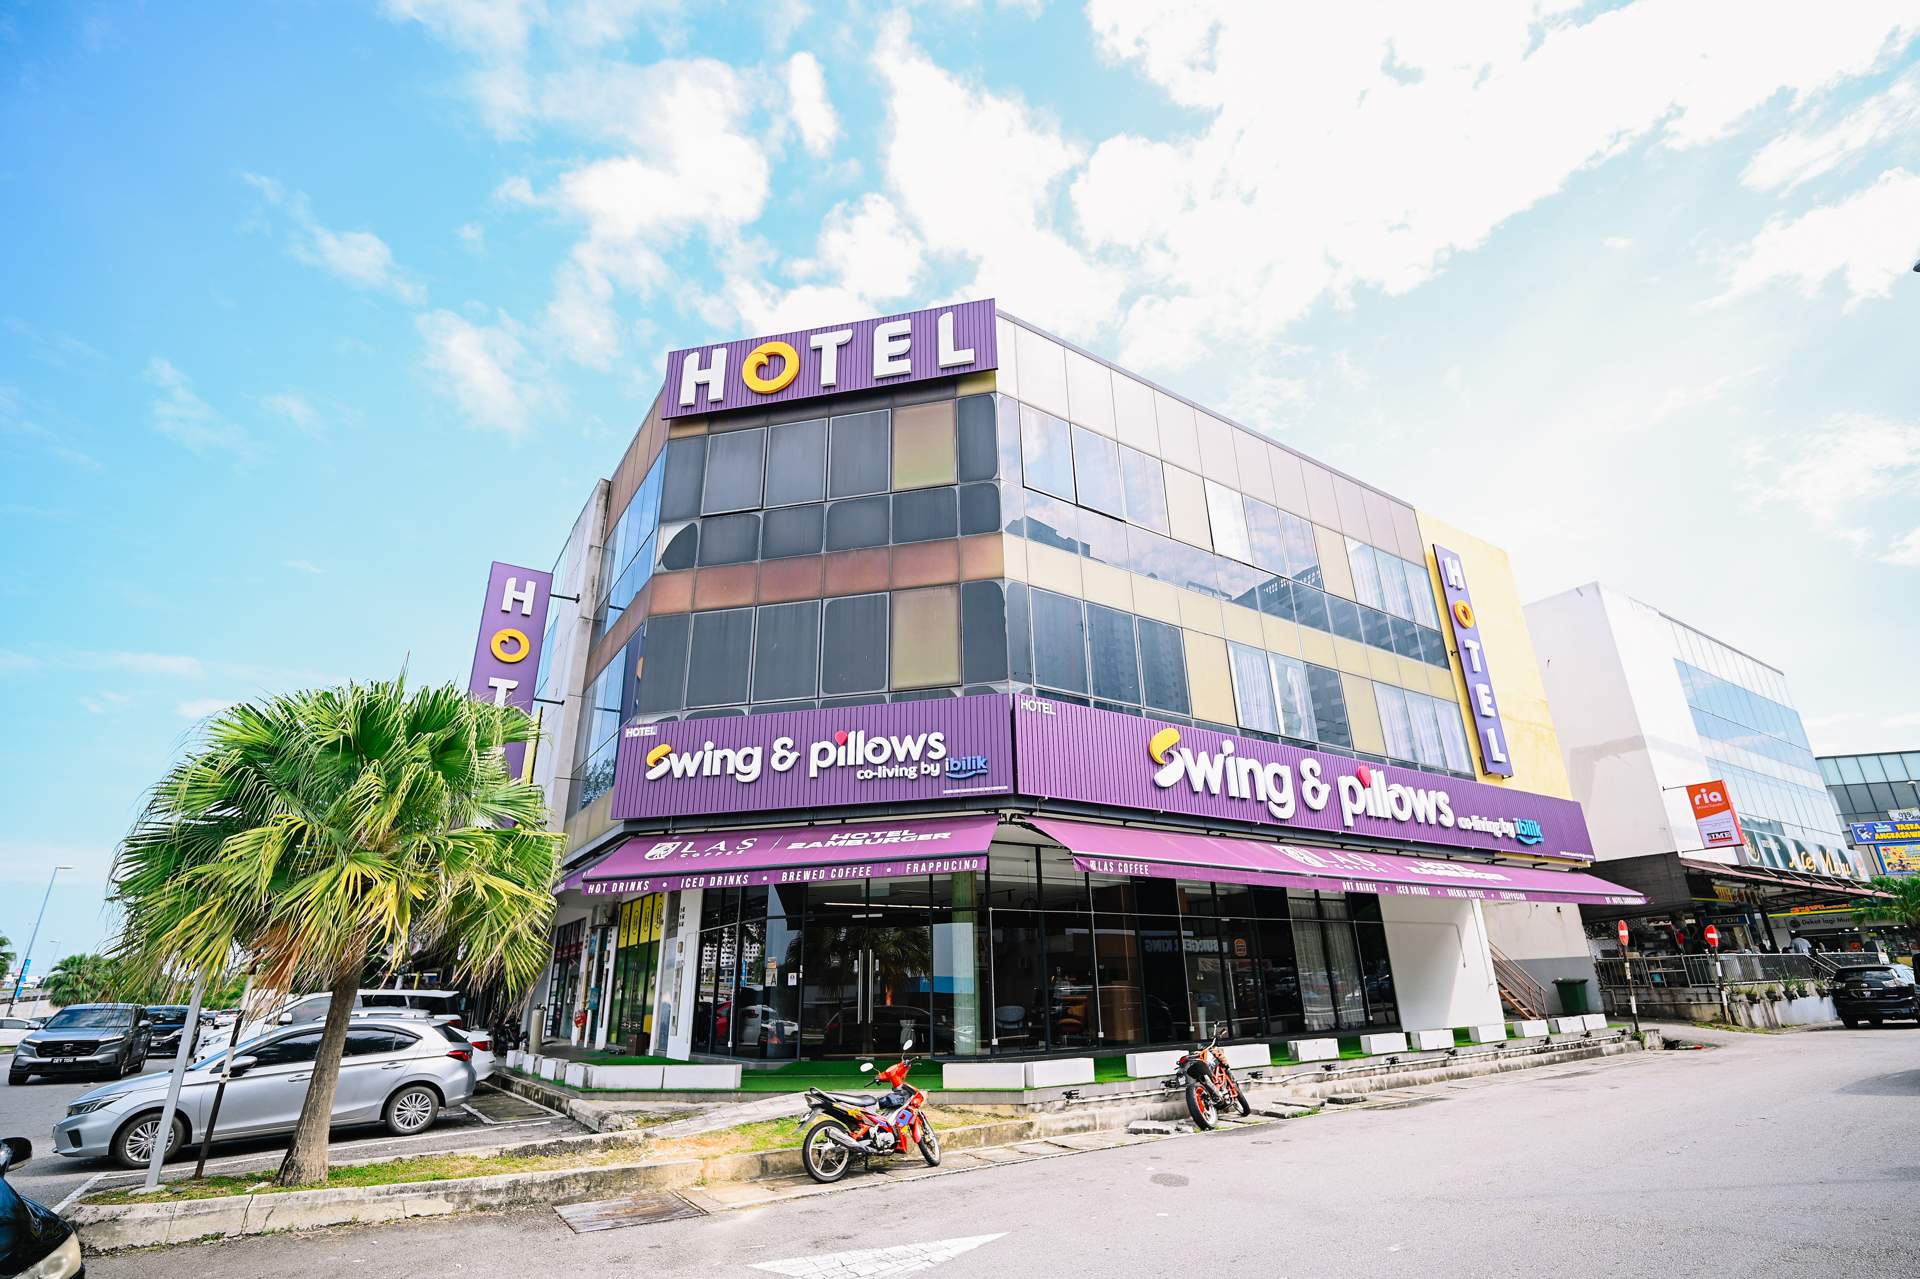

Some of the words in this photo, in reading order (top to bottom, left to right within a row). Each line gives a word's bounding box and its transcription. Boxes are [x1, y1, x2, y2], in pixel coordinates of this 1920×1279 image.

[679, 312, 975, 406] HOTEL
[488, 577, 537, 707] HOT
[1443, 557, 1507, 763] HOTEL
[1020, 698, 1057, 716] HOTEL
[625, 726, 657, 738] HOTEL
[770, 736, 801, 772] &
[809, 729, 947, 778] pillows
[856, 764, 918, 780] co-living
[920, 761, 941, 777] by
[945, 755, 988, 775] ibilik
[1300, 758, 1331, 810] &
[1338, 766, 1455, 827] pillows
[1694, 788, 1723, 805] ria
[830, 829, 916, 841] HOTEL
[681, 838, 758, 853] LAS
[781, 868, 825, 882] BREWED
[831, 866, 873, 879] COFFEE
[906, 859, 979, 873] FRAPPUCINO
[1098, 860, 1114, 872] LAS
[1118, 862, 1149, 875] COFFEE
[588, 883, 607, 894] HOT
[611, 881, 650, 893] DRINKS
[680, 877, 705, 889] ICED
[710, 874, 749, 887] DRINKS
